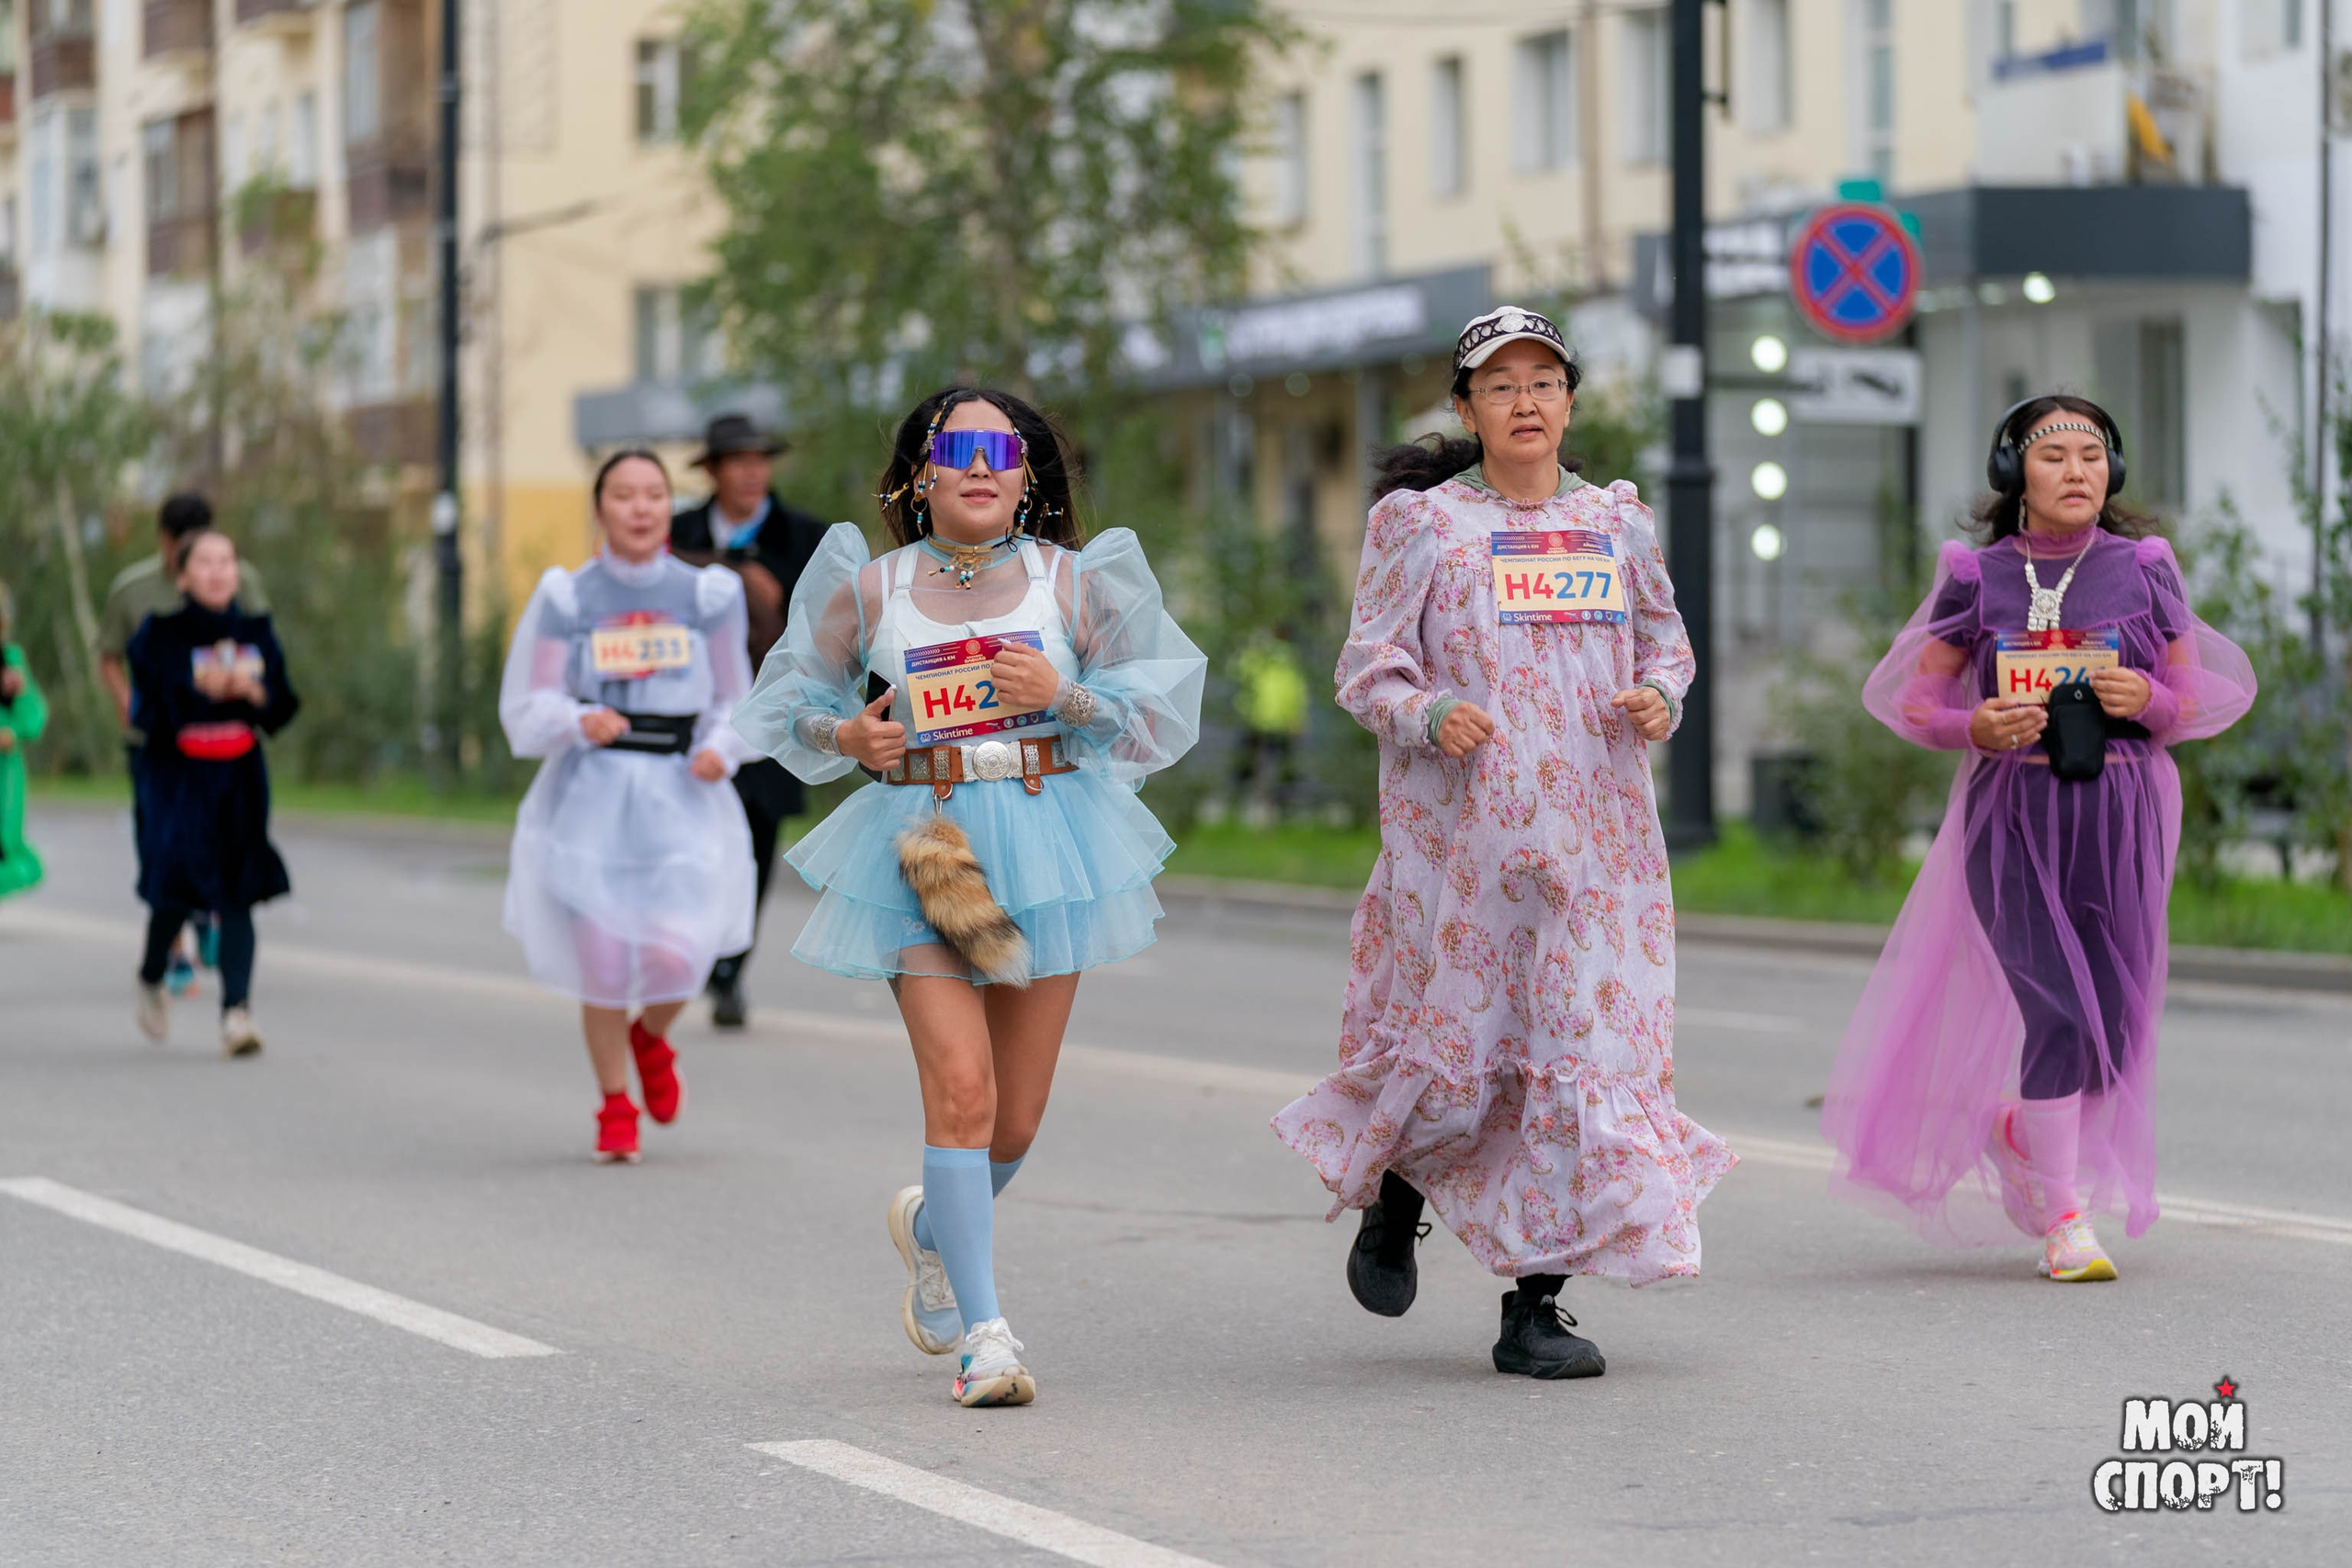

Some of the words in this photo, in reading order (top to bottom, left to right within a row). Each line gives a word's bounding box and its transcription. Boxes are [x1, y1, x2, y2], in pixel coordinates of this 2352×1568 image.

[1505, 571, 1611, 600] Н4277
[1513, 613, 1553, 622] Skintime
[911, 657, 944, 667] ДИСТАНЦИЯ
[915, 670, 954, 681] ЧЕМПИОНАТ
[955, 665, 980, 674] РОССИИ
[2010, 666, 2106, 693] Н424
[922, 680, 1000, 719] Н42
[933, 728, 974, 741] Skintime
